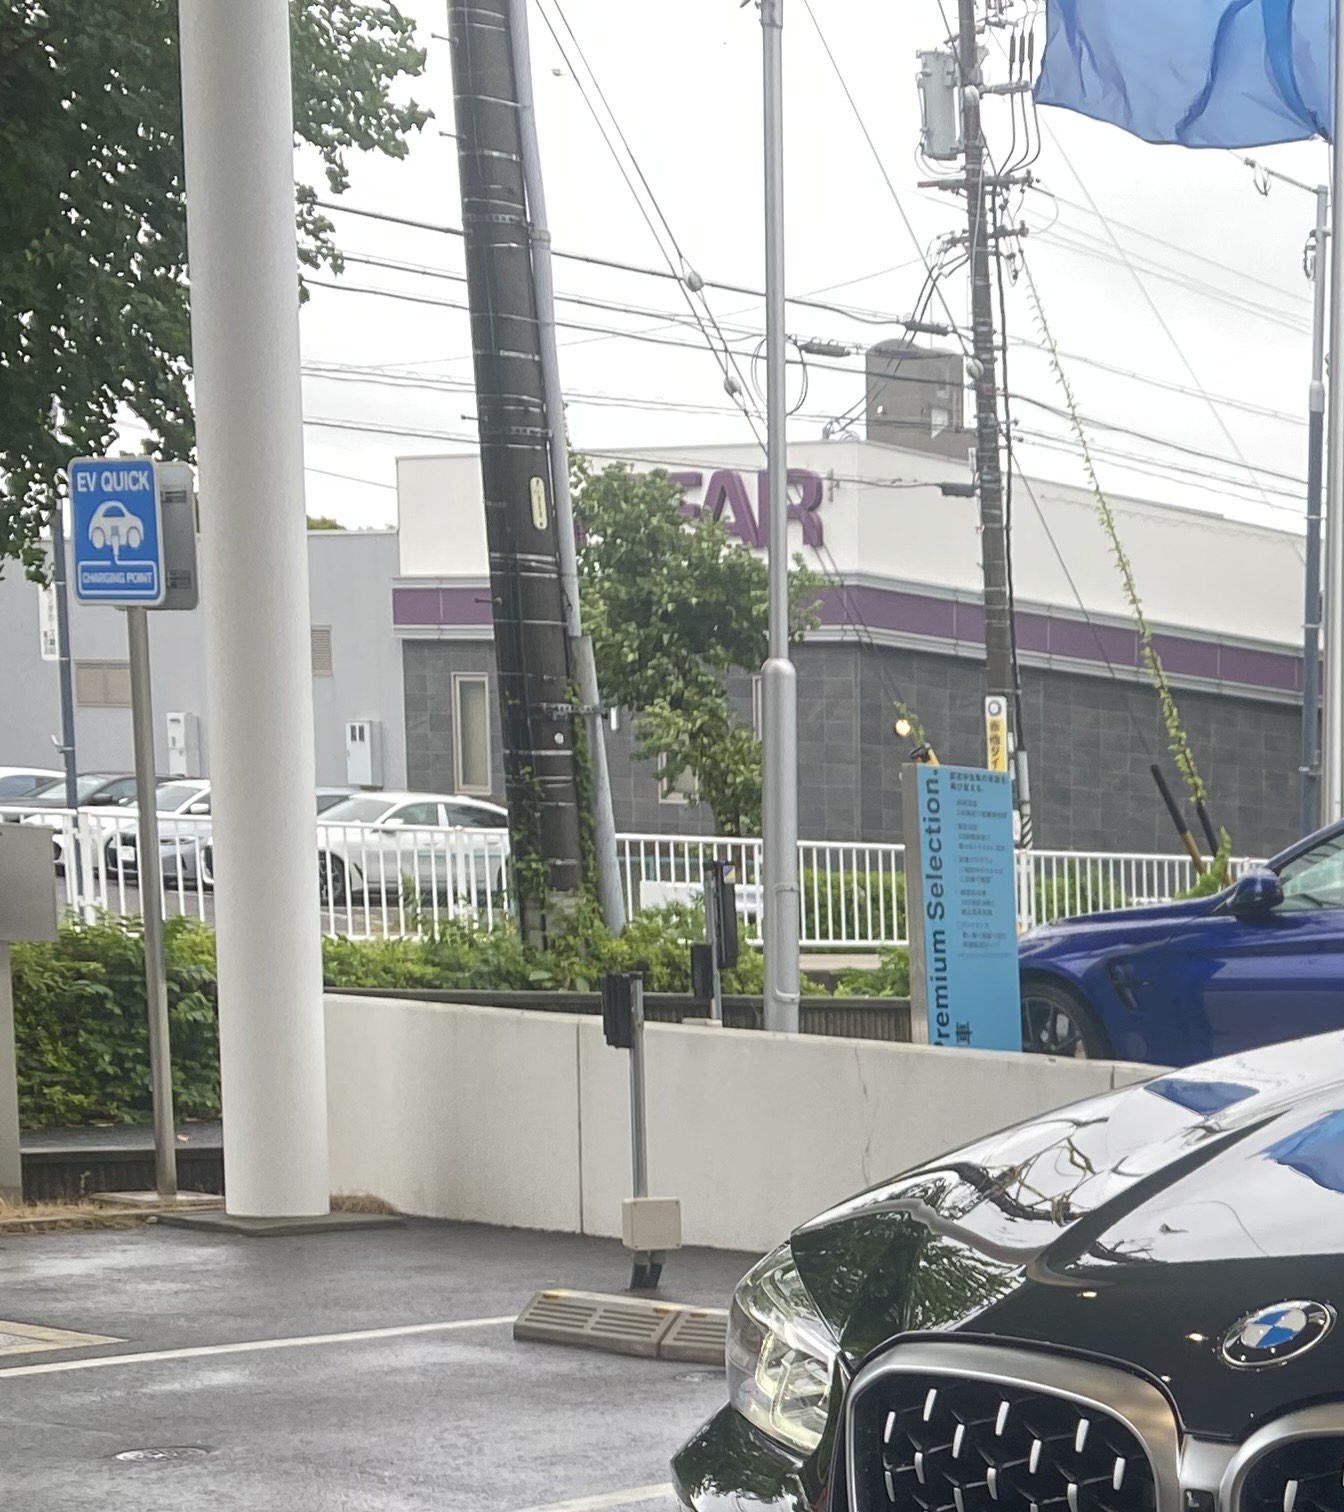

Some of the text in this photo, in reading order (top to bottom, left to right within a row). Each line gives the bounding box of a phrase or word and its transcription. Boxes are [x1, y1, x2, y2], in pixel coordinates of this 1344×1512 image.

[76, 470, 150, 493] EV QUICK
[81, 572, 153, 584] CHARGING POINT
[923, 768, 946, 921] Selection.
